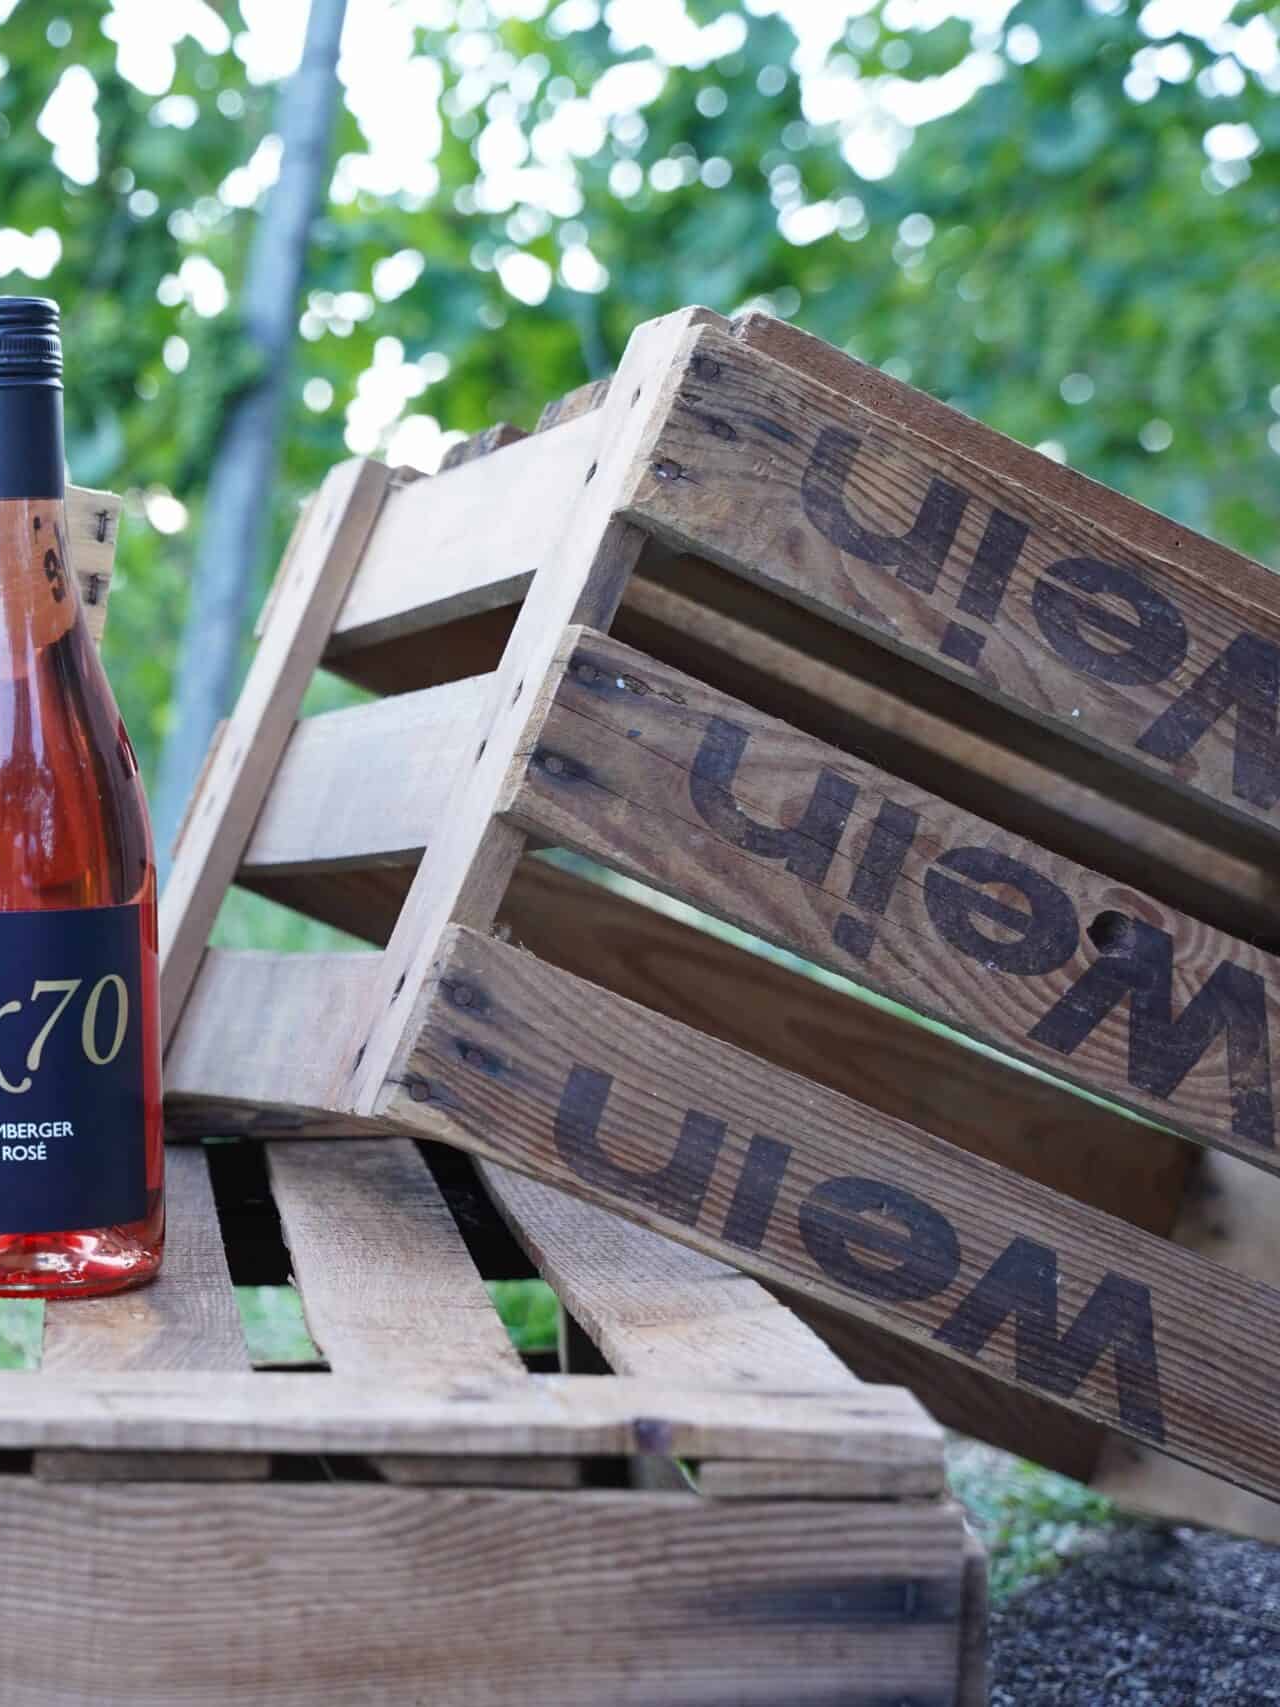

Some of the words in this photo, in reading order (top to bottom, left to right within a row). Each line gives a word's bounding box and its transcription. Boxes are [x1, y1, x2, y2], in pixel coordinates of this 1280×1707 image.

[688, 711, 1276, 1150] Wein
[1, 1142, 48, 1161] ROSÉ
[553, 1062, 1166, 1444] Wein
